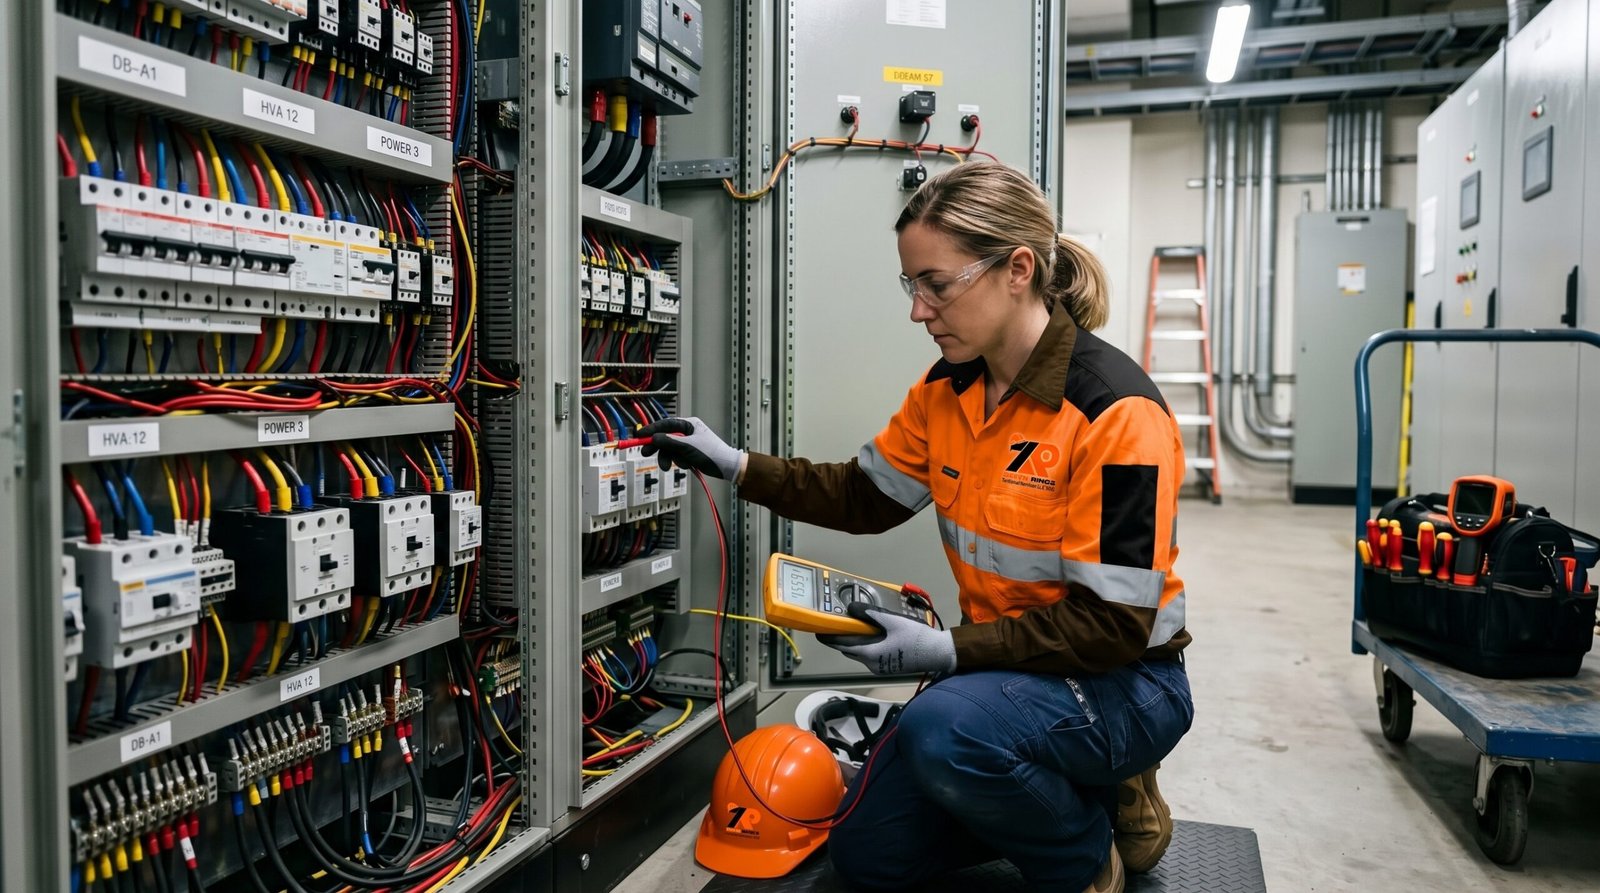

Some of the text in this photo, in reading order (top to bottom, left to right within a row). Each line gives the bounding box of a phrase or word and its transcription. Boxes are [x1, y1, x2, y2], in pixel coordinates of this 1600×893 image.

[112, 54, 157, 81] DB-A1
[261, 99, 299, 124] HVA 12
[381, 135, 420, 158] POWER 3
[264, 420, 304, 435] POWER 3
[286, 675, 314, 694] HVA 12
[131, 730, 161, 752] DB-A1
